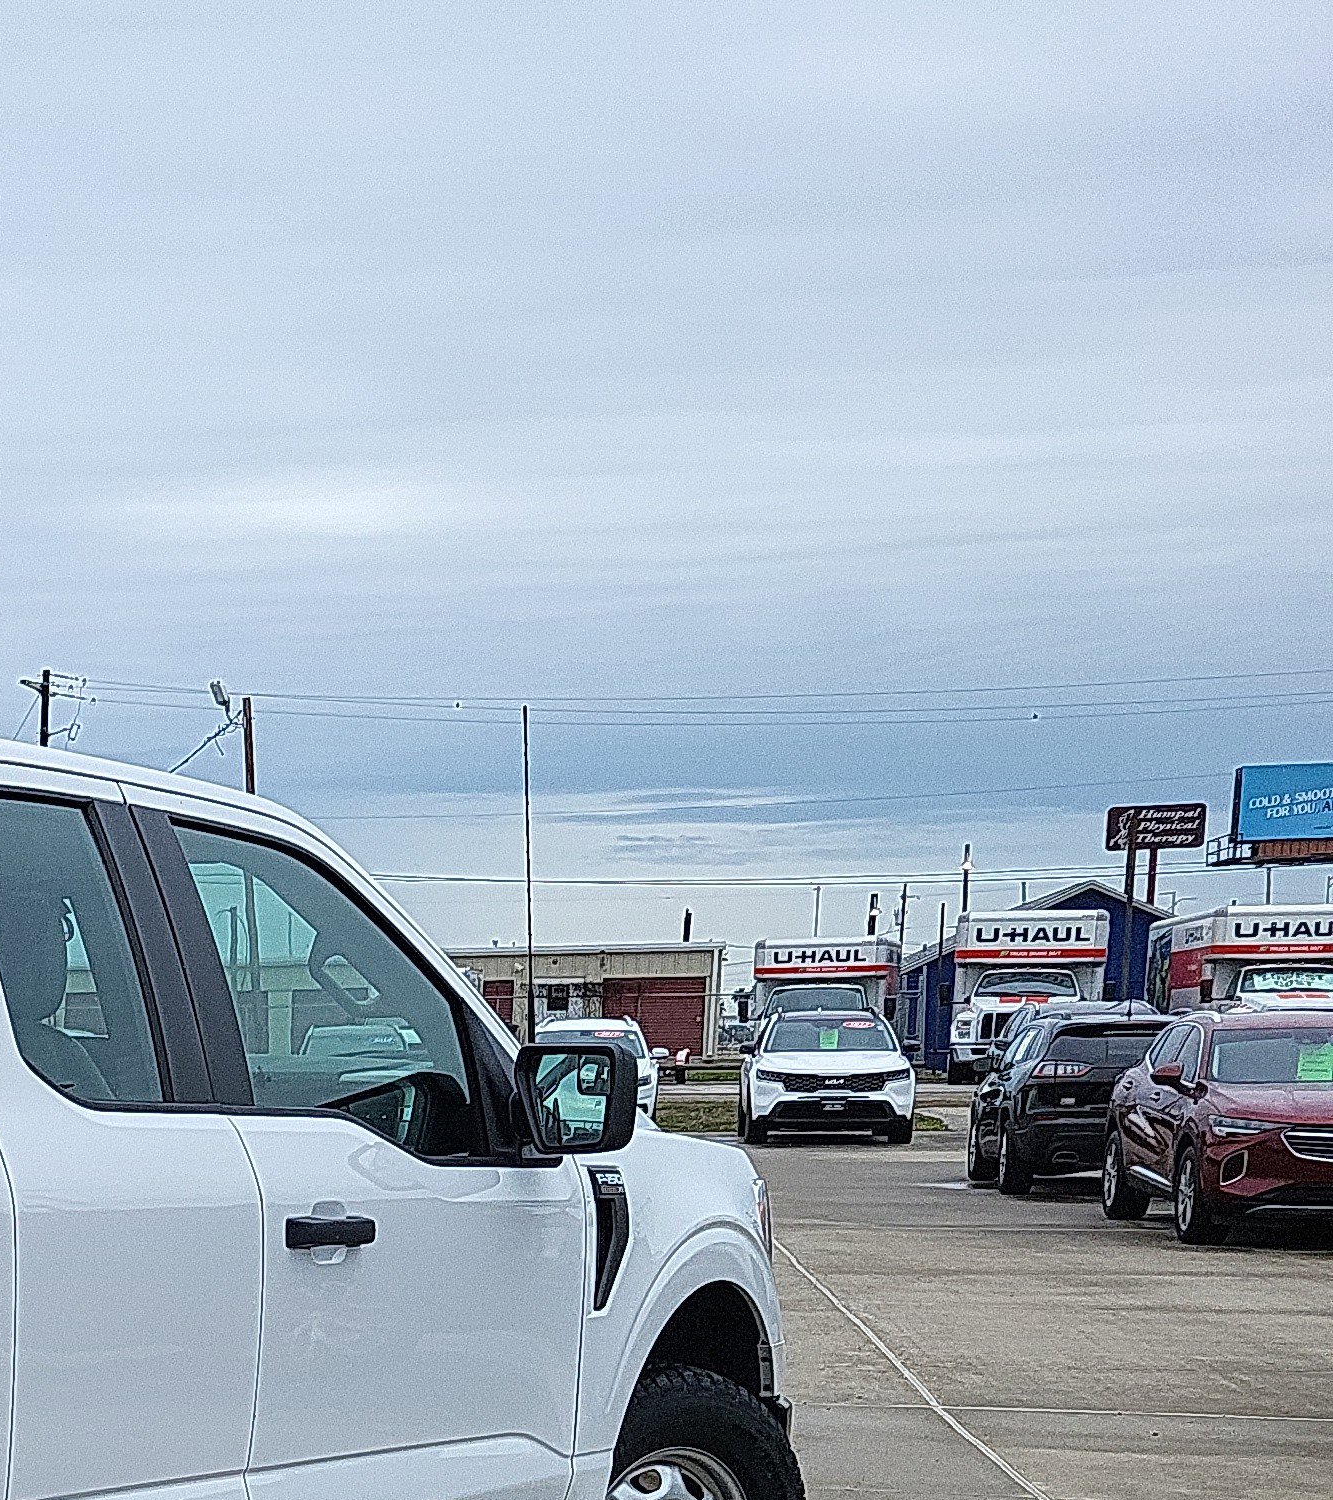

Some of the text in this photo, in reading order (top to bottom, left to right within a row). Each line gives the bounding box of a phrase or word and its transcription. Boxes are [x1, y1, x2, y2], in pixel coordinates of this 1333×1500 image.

[1249, 795, 1280, 808] COLD
[1282, 794, 1292, 804] &
[1137, 808, 1202, 820] Humpal
[1266, 806, 1290, 818] FOR
[1137, 820, 1201, 833] Physical
[1136, 833, 1196, 844] Therapy
[975, 926, 1091, 943] U-HAUL
[773, 949, 867, 964] U-HAUL
